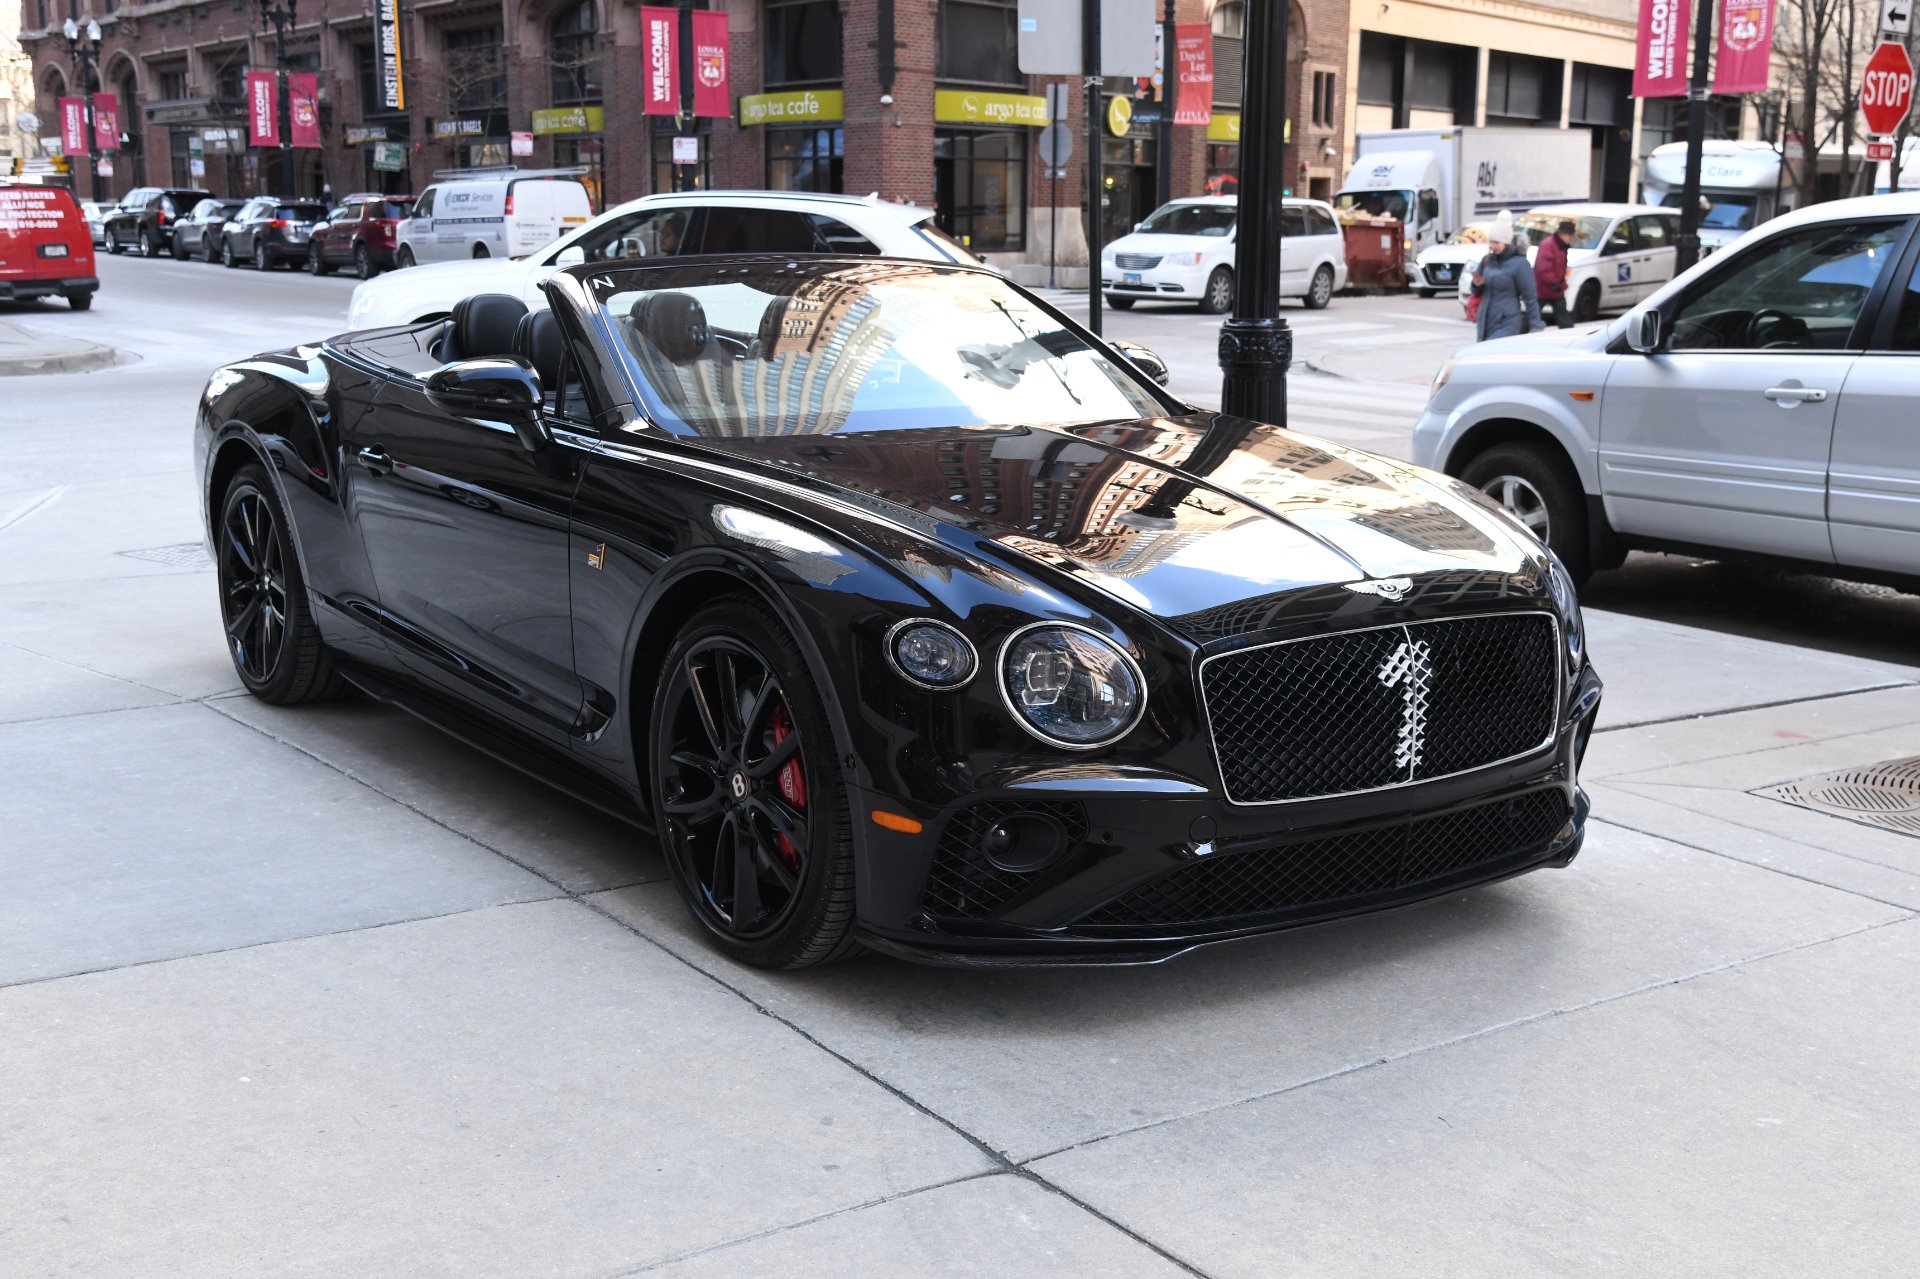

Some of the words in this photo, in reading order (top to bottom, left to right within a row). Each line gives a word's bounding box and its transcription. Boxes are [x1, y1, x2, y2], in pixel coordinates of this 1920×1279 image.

[1647, 0, 1669, 80] WELCO
[651, 20, 664, 102] WELCOME
[384, 56, 399, 108] EINSTEIN
[1864, 71, 1909, 107] STOP
[254, 80, 269, 137] WELCOME
[787, 92, 819, 115] café
[984, 102, 1014, 122] argo
[1476, 160, 1497, 187] Abt
[1707, 165, 1744, 177] Clare
